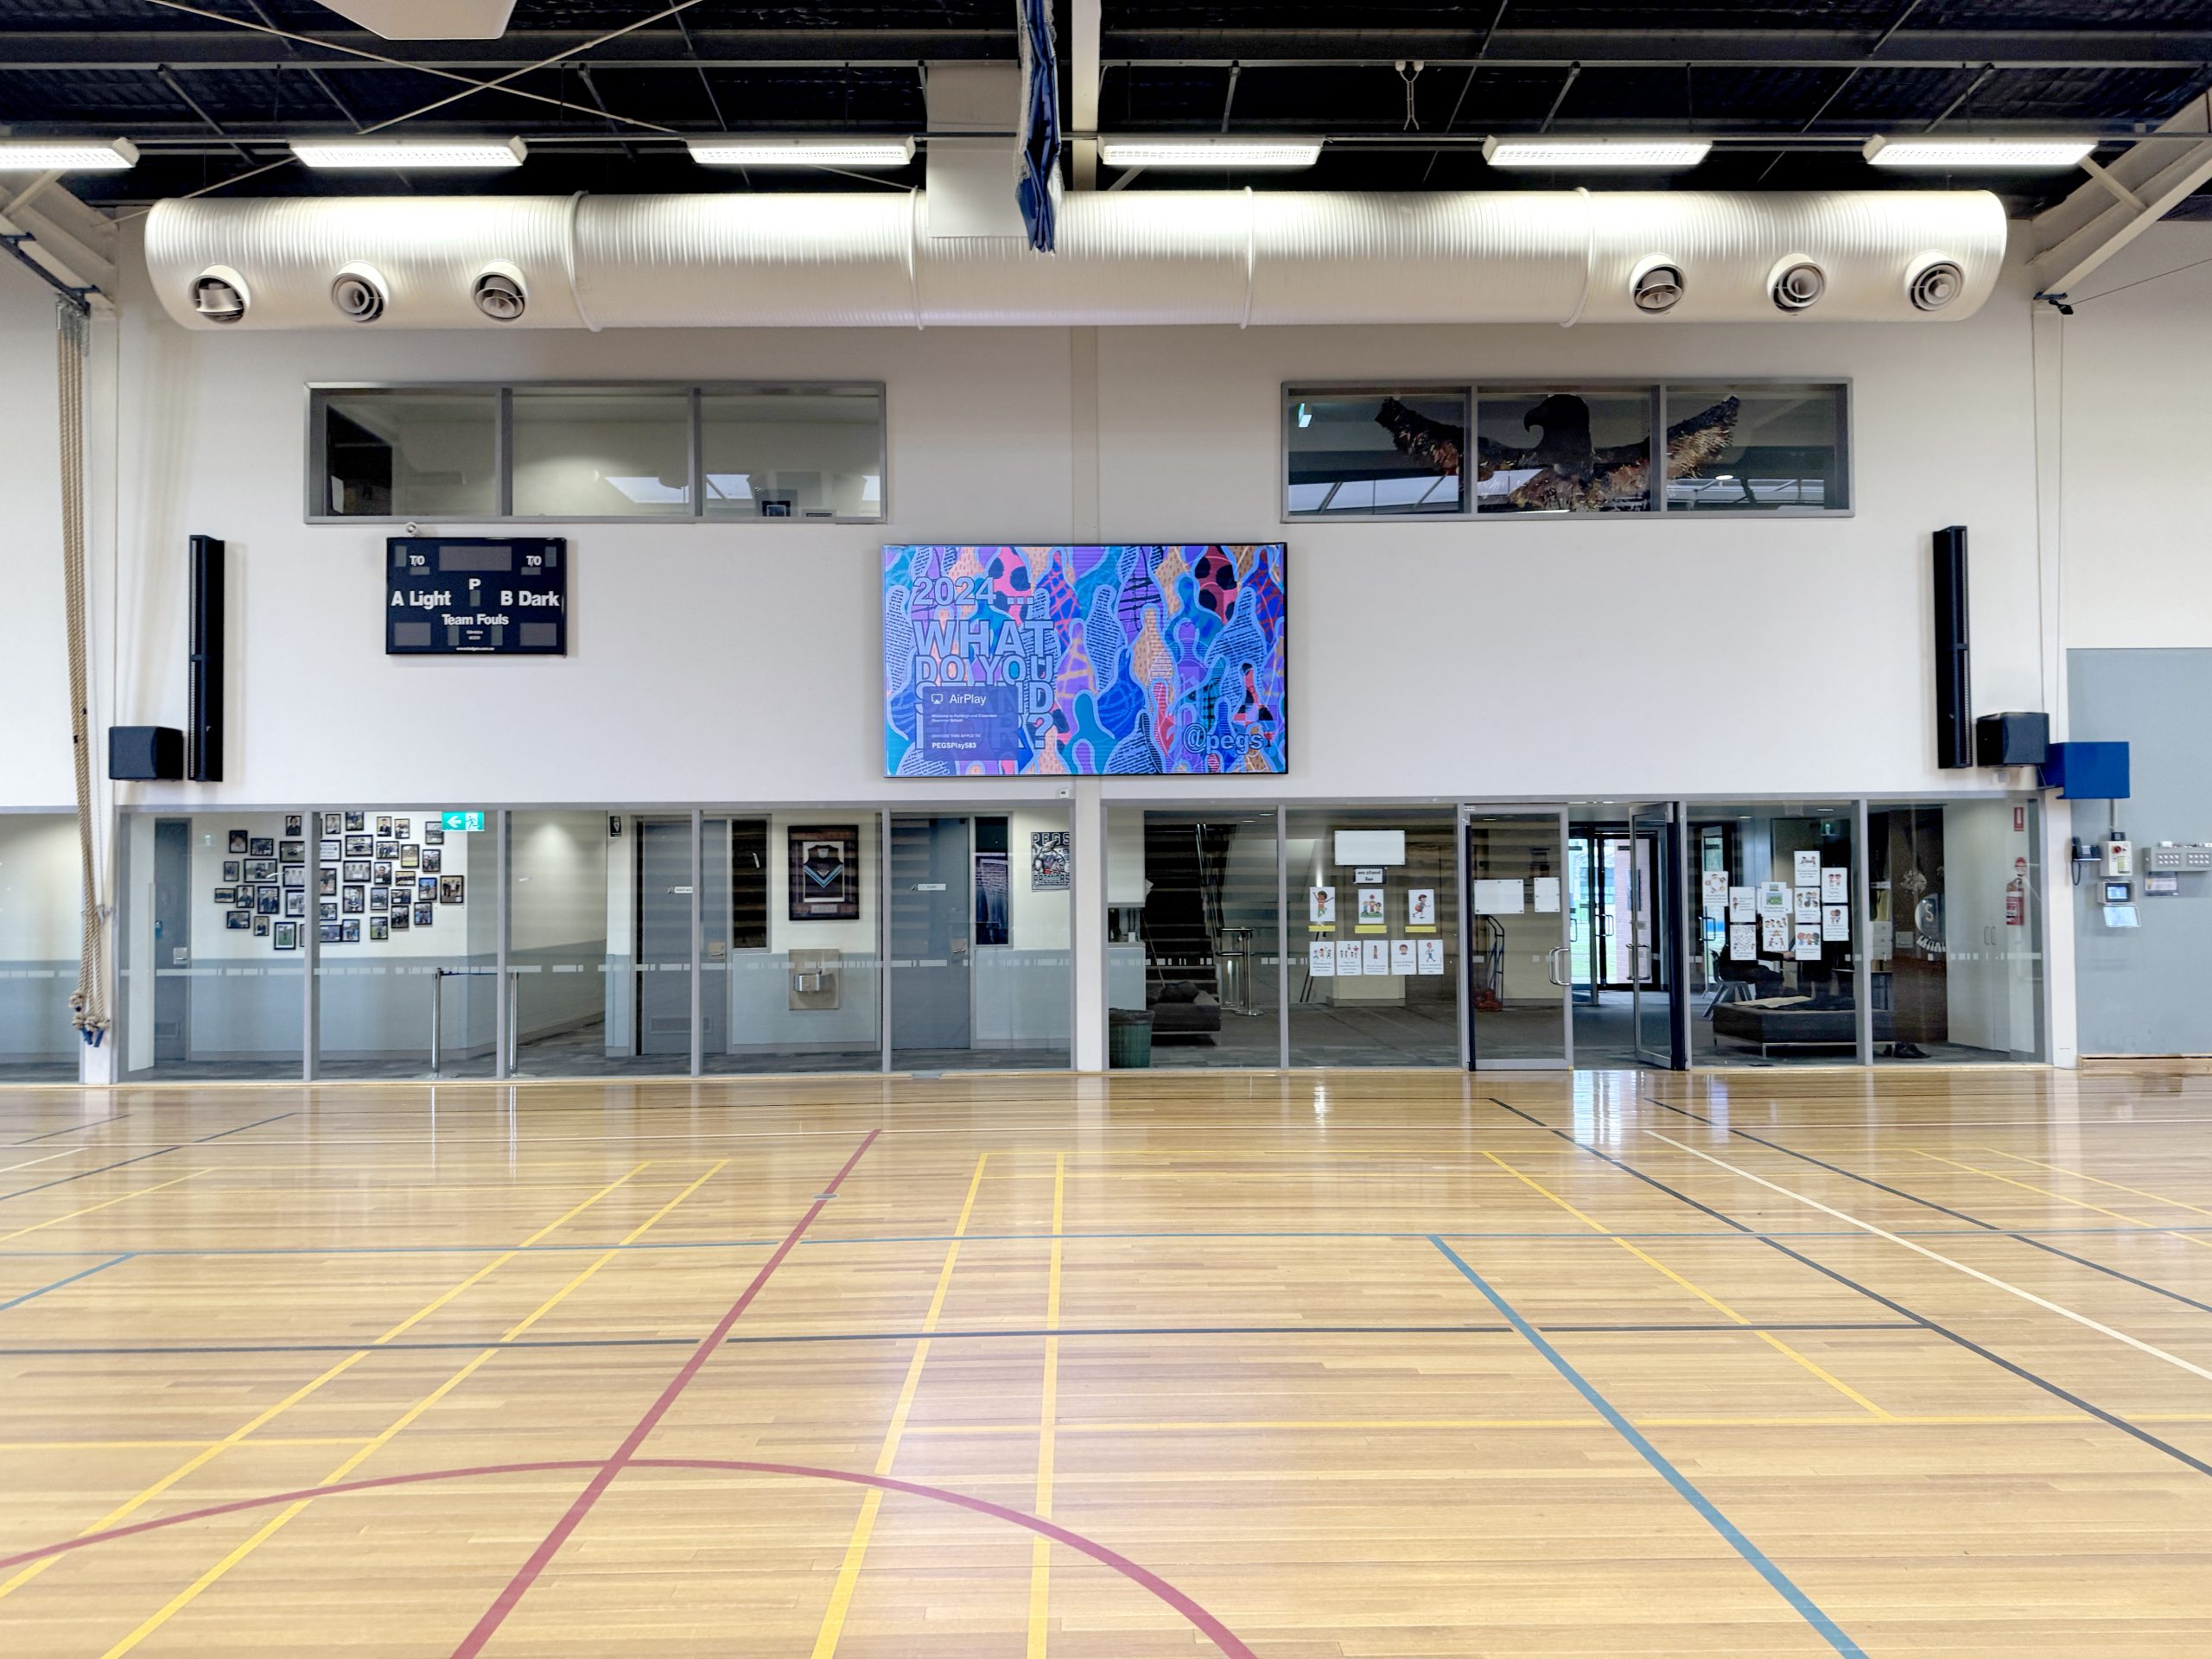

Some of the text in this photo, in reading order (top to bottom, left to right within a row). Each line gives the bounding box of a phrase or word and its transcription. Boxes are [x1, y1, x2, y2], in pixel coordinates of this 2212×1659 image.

[410, 556, 425, 567] T/O
[526, 556, 542, 567] T/O
[468, 578, 481, 589] P
[912, 576, 996, 606] 2024
[391, 591, 451, 610] A Light
[500, 591, 560, 607] B Dark
[442, 613, 509, 626] Team Fouls
[912, 620, 1055, 658] WHAT
[915, 654, 1054, 684] DO YOU
[949, 694, 987, 706] AirPlay
[1183, 723, 1264, 755] @pegs
